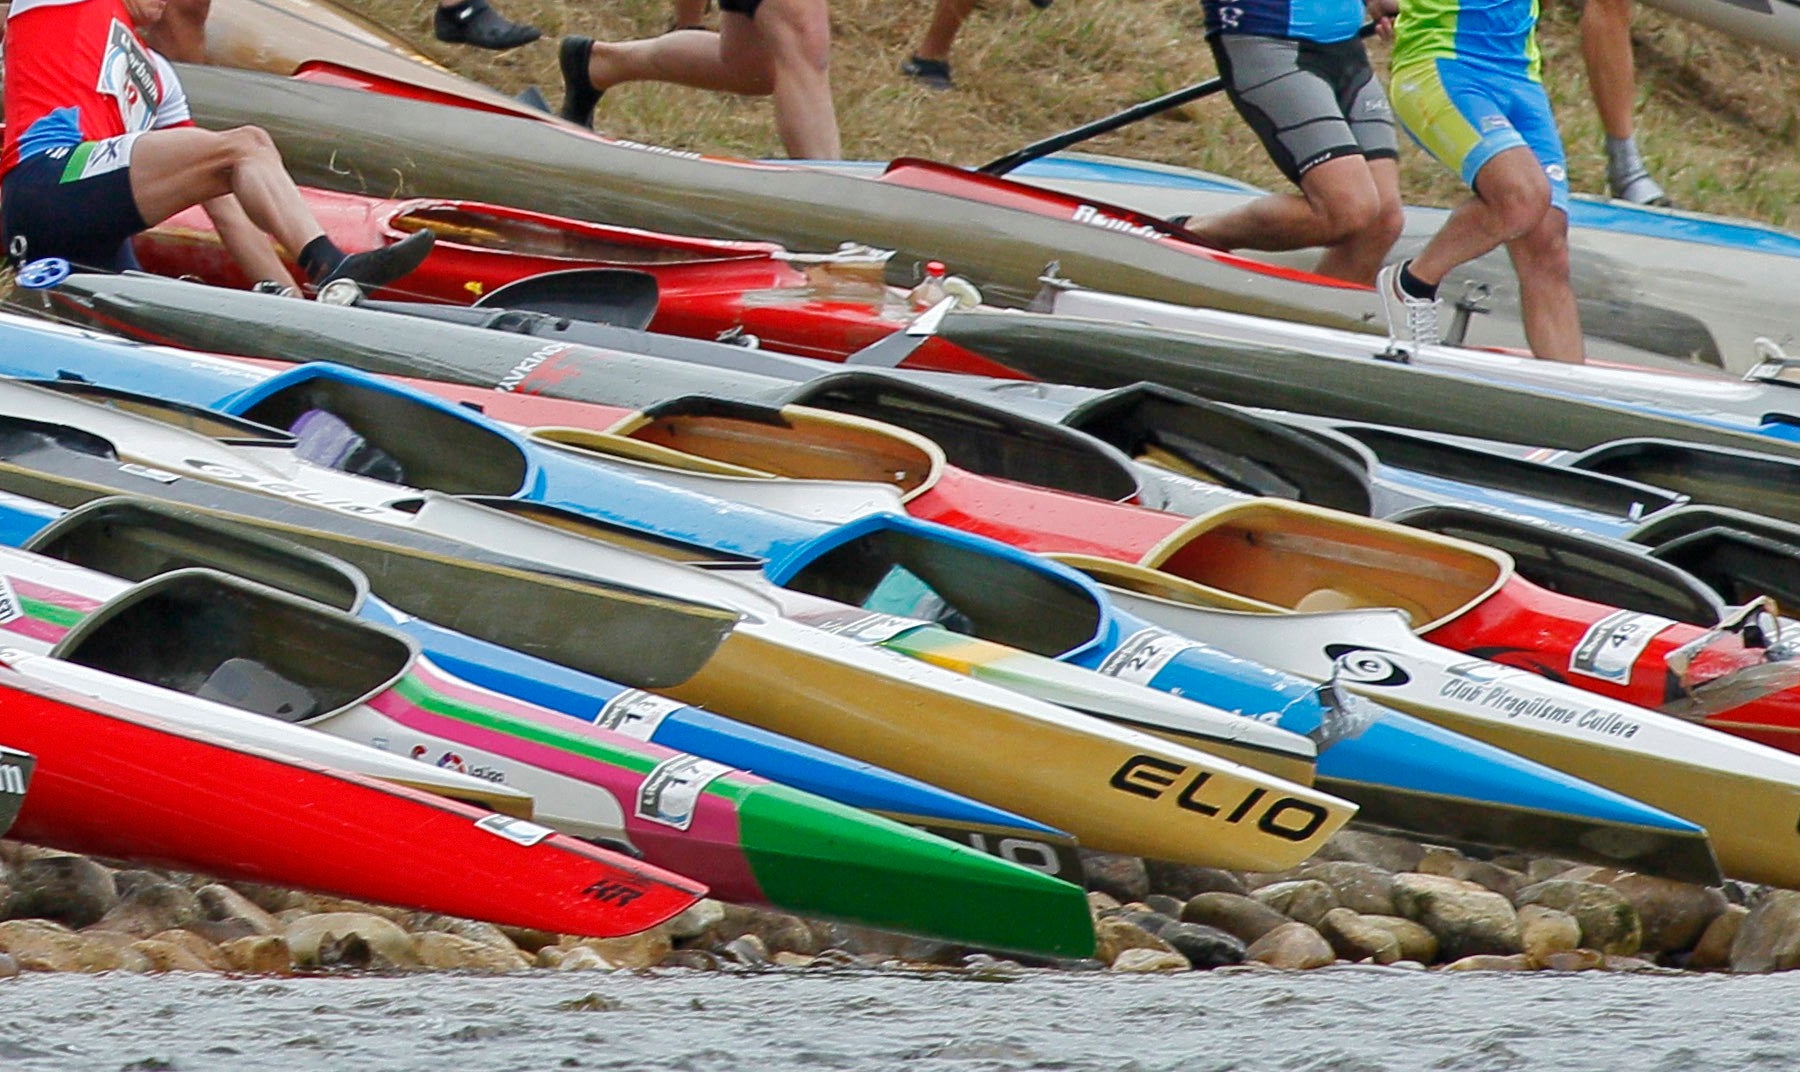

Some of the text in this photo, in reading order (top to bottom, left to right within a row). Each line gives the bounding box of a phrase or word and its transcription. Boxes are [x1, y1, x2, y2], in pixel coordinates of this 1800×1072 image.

[1611, 621, 1641, 649] 49
[1125, 645, 1160, 672] 22
[1439, 678, 1641, 740] Club Piragüisme Cullera
[1109, 753, 1330, 842] ELIO
